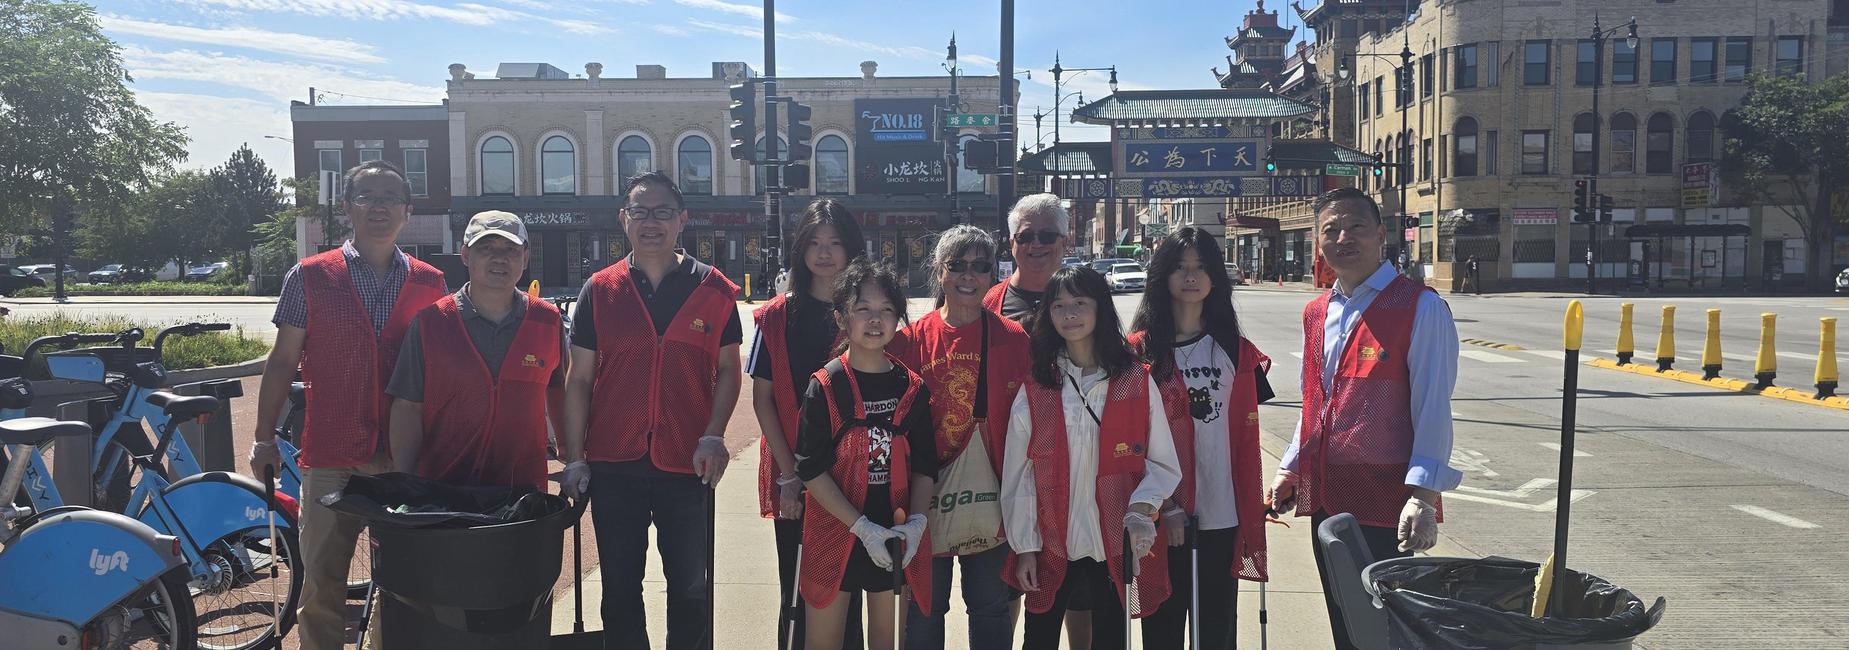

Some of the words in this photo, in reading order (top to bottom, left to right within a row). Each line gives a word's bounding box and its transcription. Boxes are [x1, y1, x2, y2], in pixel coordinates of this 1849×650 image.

[881, 113, 923, 129] NO.18
[245, 506, 266, 521] lyft
[89, 548, 130, 576] lyft
